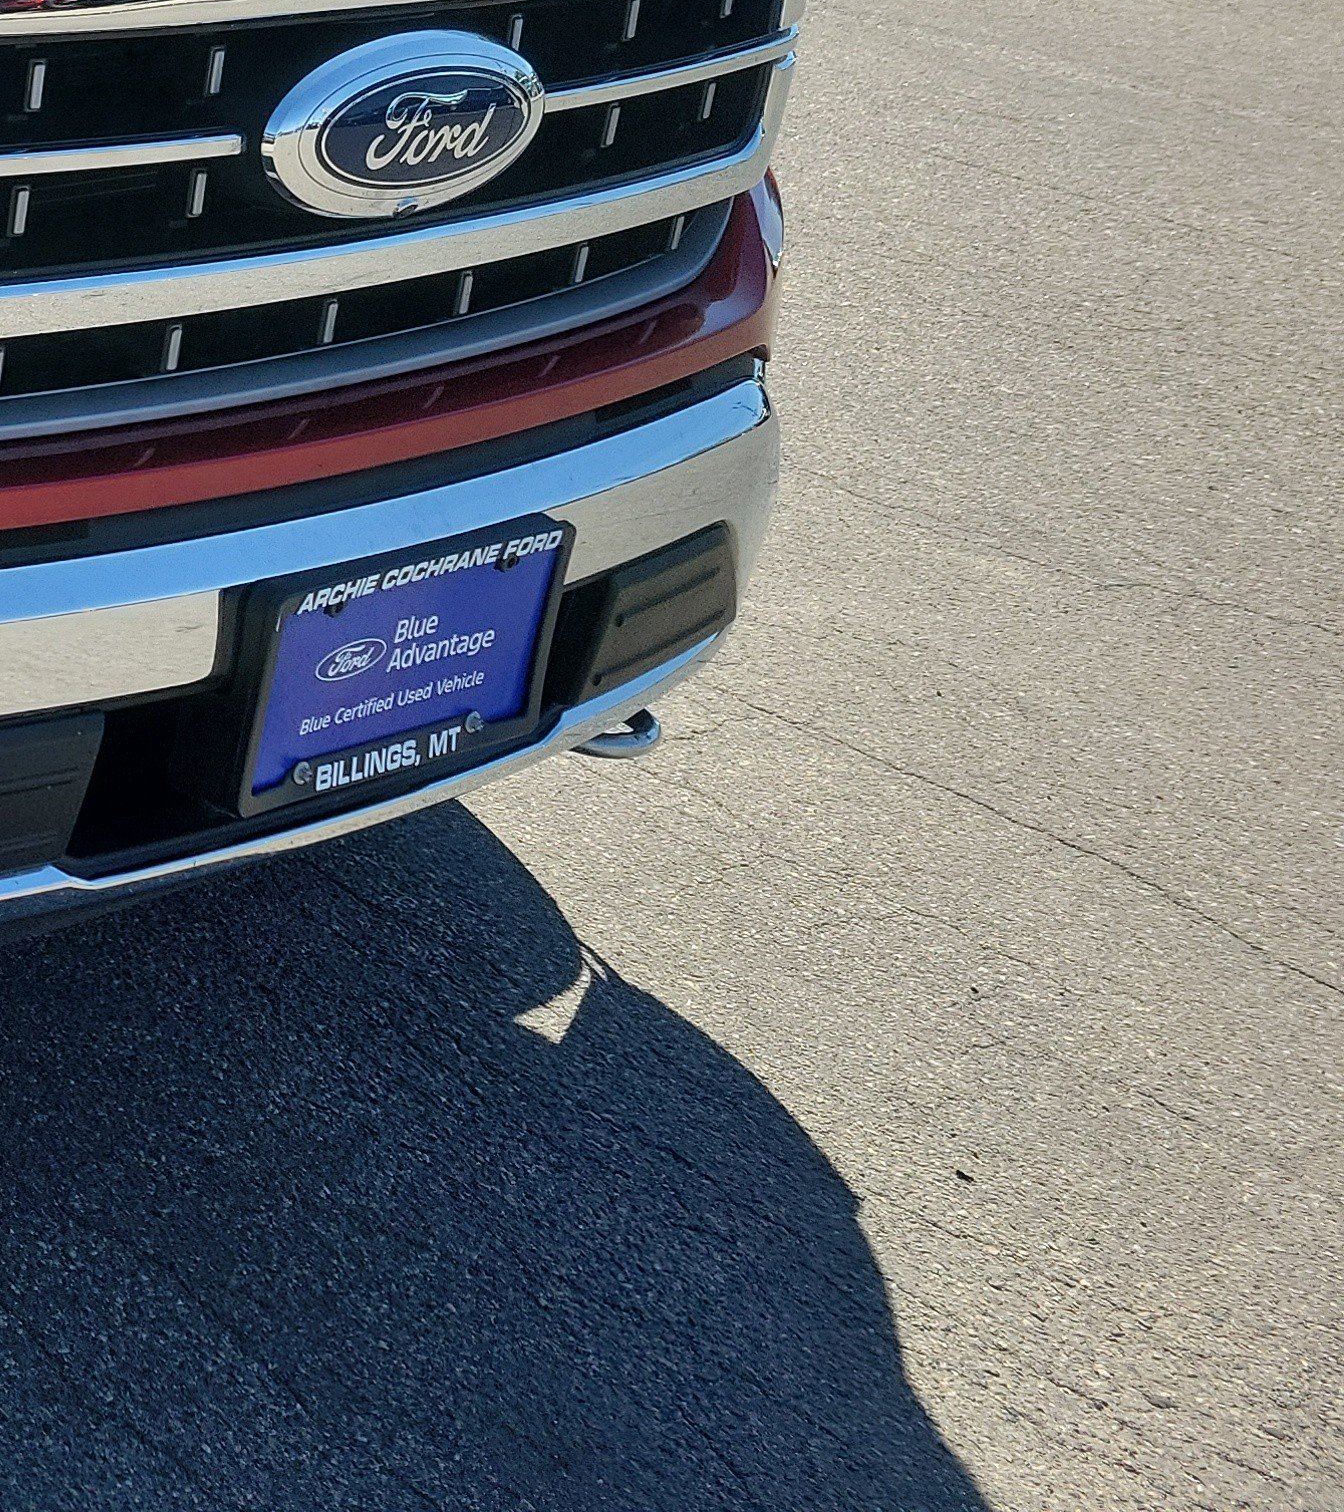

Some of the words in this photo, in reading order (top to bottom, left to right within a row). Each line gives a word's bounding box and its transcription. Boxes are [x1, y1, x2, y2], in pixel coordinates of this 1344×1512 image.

[366, 89, 497, 170] Ford
[296, 572, 381, 616] ARCHIE
[381, 545, 500, 591] COCHRANE
[502, 530, 563, 561] FORD
[327, 644, 375, 678] Ford
[386, 628, 496, 673] Advantage
[393, 615, 439, 645] Blue
[299, 713, 331, 737] Blue
[333, 693, 394, 726] Certified
[396, 684, 432, 710] Used
[436, 669, 485, 699] Vehicle
[314, 737, 421, 791] BILLINGS,
[427, 725, 462, 759] MT
